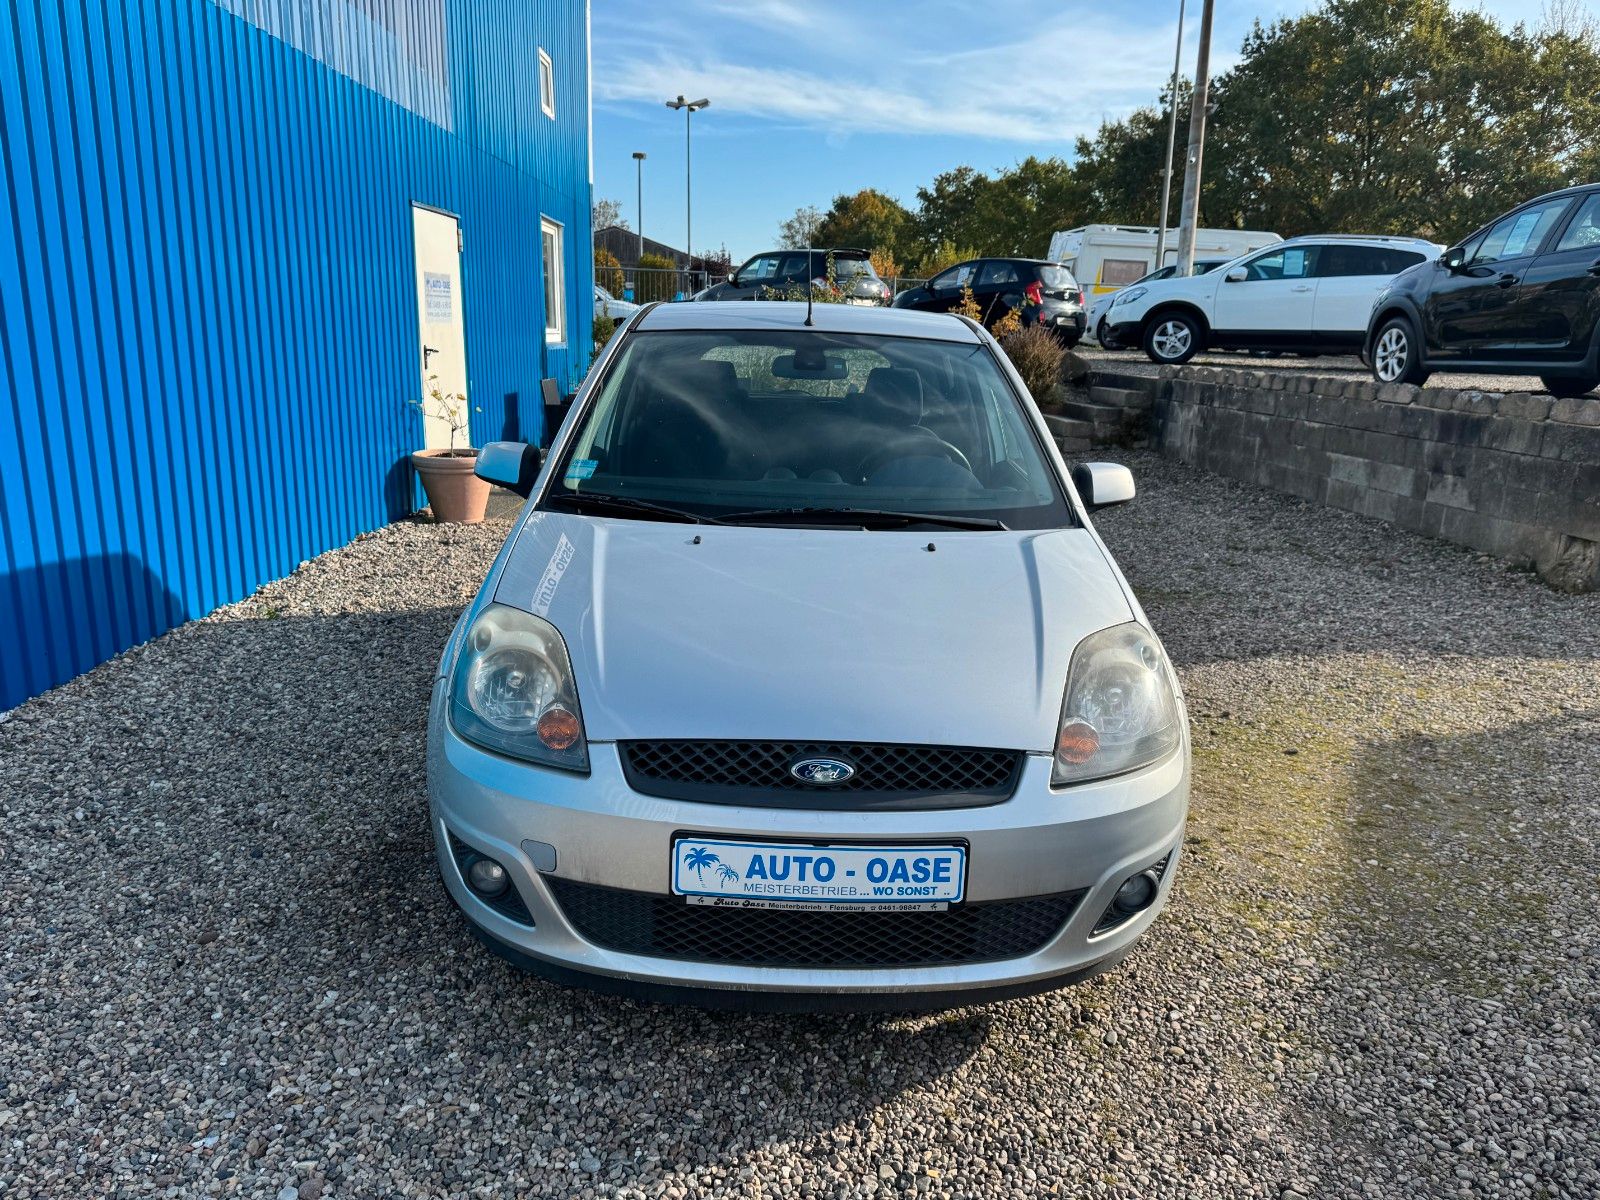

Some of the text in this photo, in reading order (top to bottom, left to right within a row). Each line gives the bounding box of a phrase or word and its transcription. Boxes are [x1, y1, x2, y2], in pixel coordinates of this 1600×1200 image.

[804, 764, 840, 779] Ford
[745, 854, 836, 882] AUTO
[866, 857, 952, 884] OASE
[873, 886, 893, 896] WO
[896, 886, 938, 896] SONST
[713, 898, 740, 906] Auto
[742, 900, 766, 908] Oase
[768, 902, 822, 910] Meisterbetrieb
[829, 904, 866, 912] Flensburg
